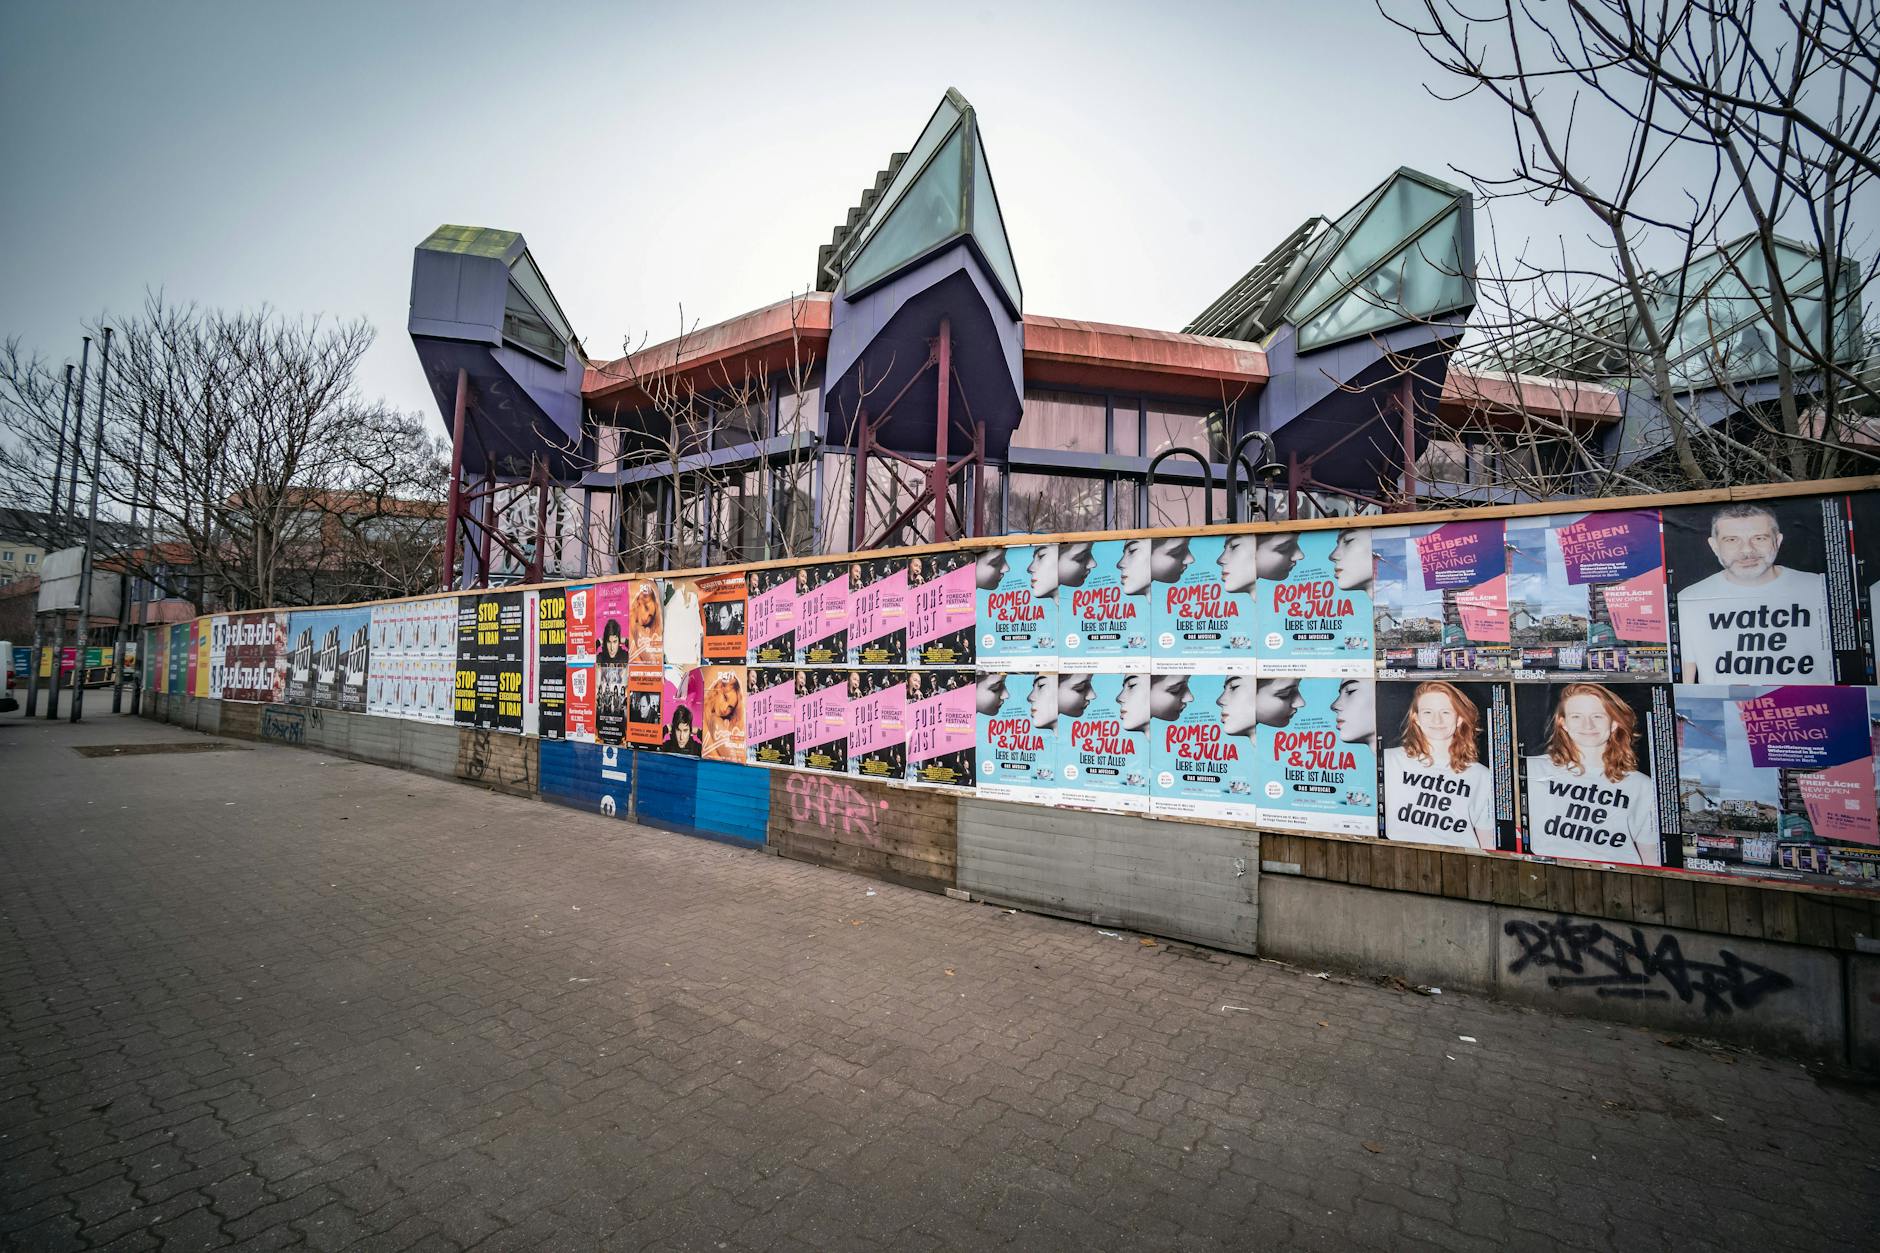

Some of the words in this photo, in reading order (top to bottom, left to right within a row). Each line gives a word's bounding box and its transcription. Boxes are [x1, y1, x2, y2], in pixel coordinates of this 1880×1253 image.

[1414, 533, 1442, 545] WIR
[1556, 523, 1587, 536] WIR
[1558, 524, 1630, 546] BLEIBEN!
[1417, 534, 1479, 555] BLEIBEN!
[1422, 554, 1477, 573] STAYING!
[1564, 545, 1629, 566] STAYING!
[988, 590, 1031, 618] ROMEO
[1072, 586, 1121, 616] ROMEO
[1167, 583, 1221, 614] ROMEO
[1273, 581, 1335, 613] ROMEO
[478, 602, 499, 622] STOP
[540, 598, 565, 620] STOP
[1709, 603, 1811, 630] watch
[478, 631, 484, 645] IN
[485, 631, 499, 645] IRAN
[540, 630, 548, 645] IN
[548, 629, 566, 645] IRAN
[1737, 632, 1787, 651] me
[1715, 651, 1814, 675] dance
[456, 670, 476, 689] STOP
[499, 672, 522, 692] STOP
[455, 698, 462, 711] IN
[461, 698, 476, 712] IRAN
[499, 701, 506, 715] IN
[506, 701, 521, 717] IRAN
[1736, 697, 1776, 710] WIR
[1740, 703, 1830, 722] BLEIBEN!
[988, 718, 1031, 744] ROMEO
[1071, 720, 1120, 747] ROMEO
[1166, 723, 1221, 753] ROMEO
[1748, 728, 1828, 745] STAYING!
[1274, 731, 1337, 761] ROMEO
[1402, 771, 1471, 798] watch
[1549, 780, 1630, 809] watch
[1800, 779, 1861, 789] FREIFLÄCHE
[1416, 791, 1452, 811] me
[1397, 803, 1468, 833] dance
[1565, 802, 1608, 824] me
[1544, 816, 1627, 848] dance
